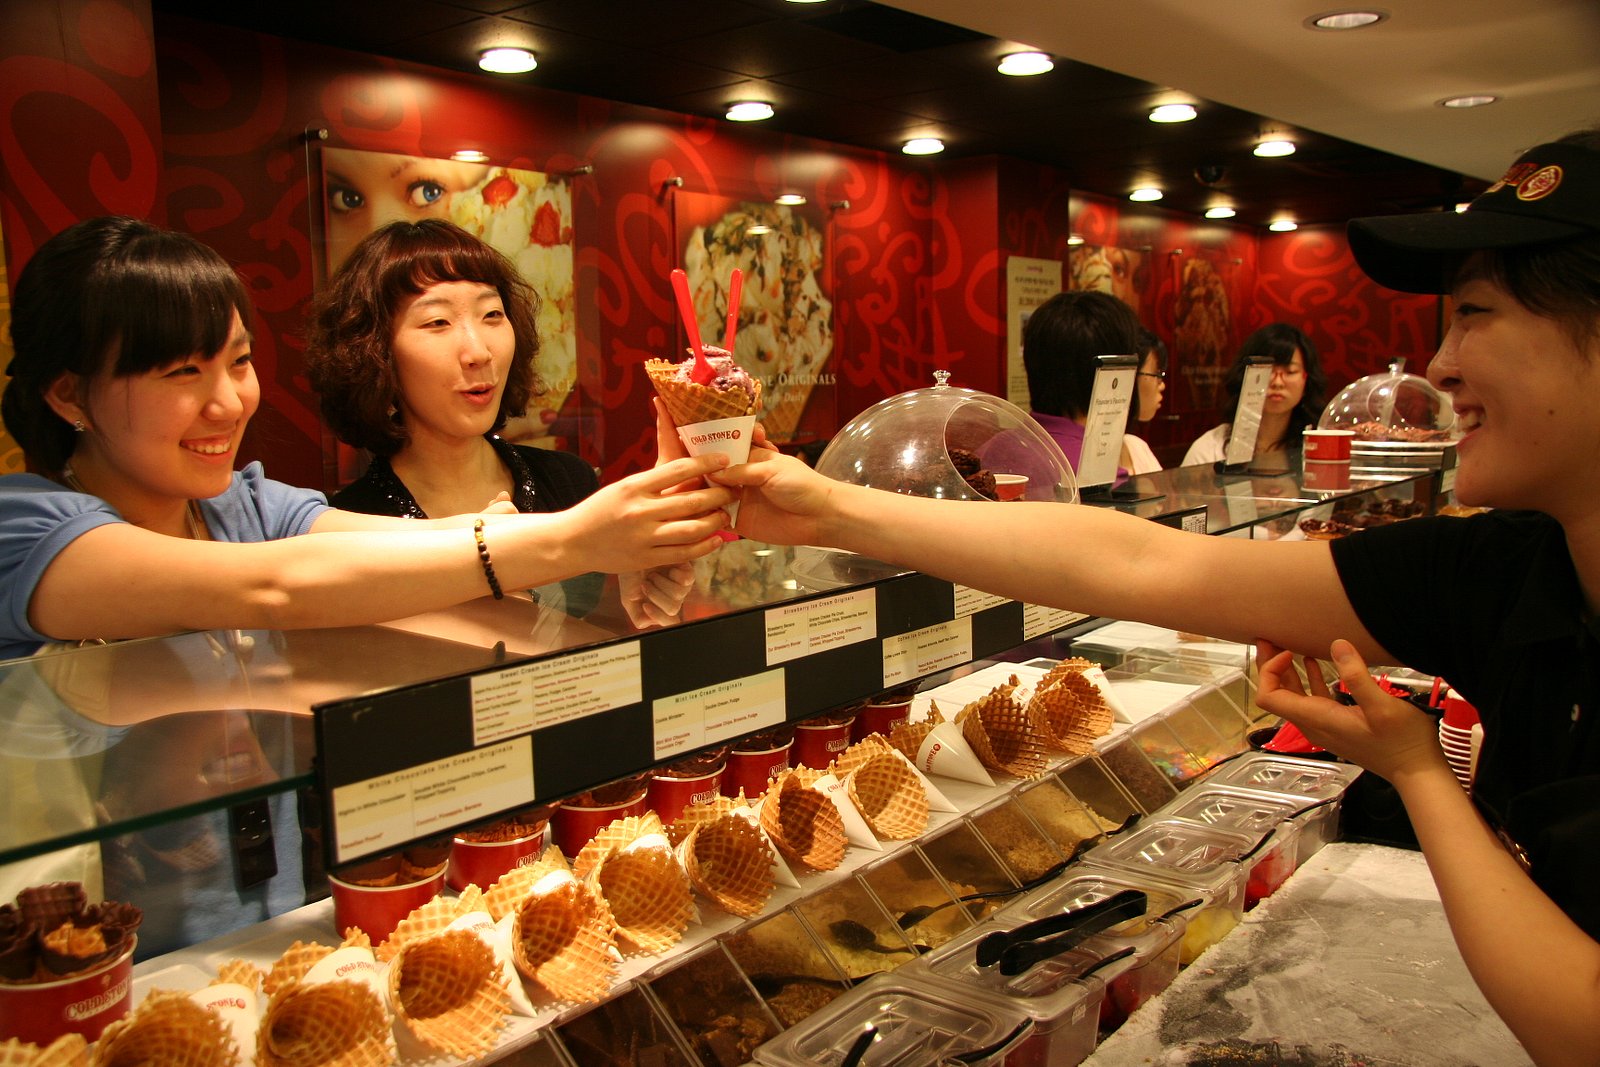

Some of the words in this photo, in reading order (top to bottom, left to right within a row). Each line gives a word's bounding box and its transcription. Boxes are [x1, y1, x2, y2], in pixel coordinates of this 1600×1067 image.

[691, 435, 707, 446] COLD
[708, 430, 731, 441] STONE
[819, 600, 833, 608] Cream
[834, 596, 854, 604] Originals
[521, 665, 540, 675] Cream
[553, 659, 571, 668] Cream
[574, 652, 599, 663] Originals
[675, 696, 688, 704] Mint
[700, 689, 716, 698] Cream
[718, 682, 743, 693] Originals
[453, 755, 476, 767] Cream
[479, 745, 514, 759] Originals
[65, 995, 103, 1020] COLD
